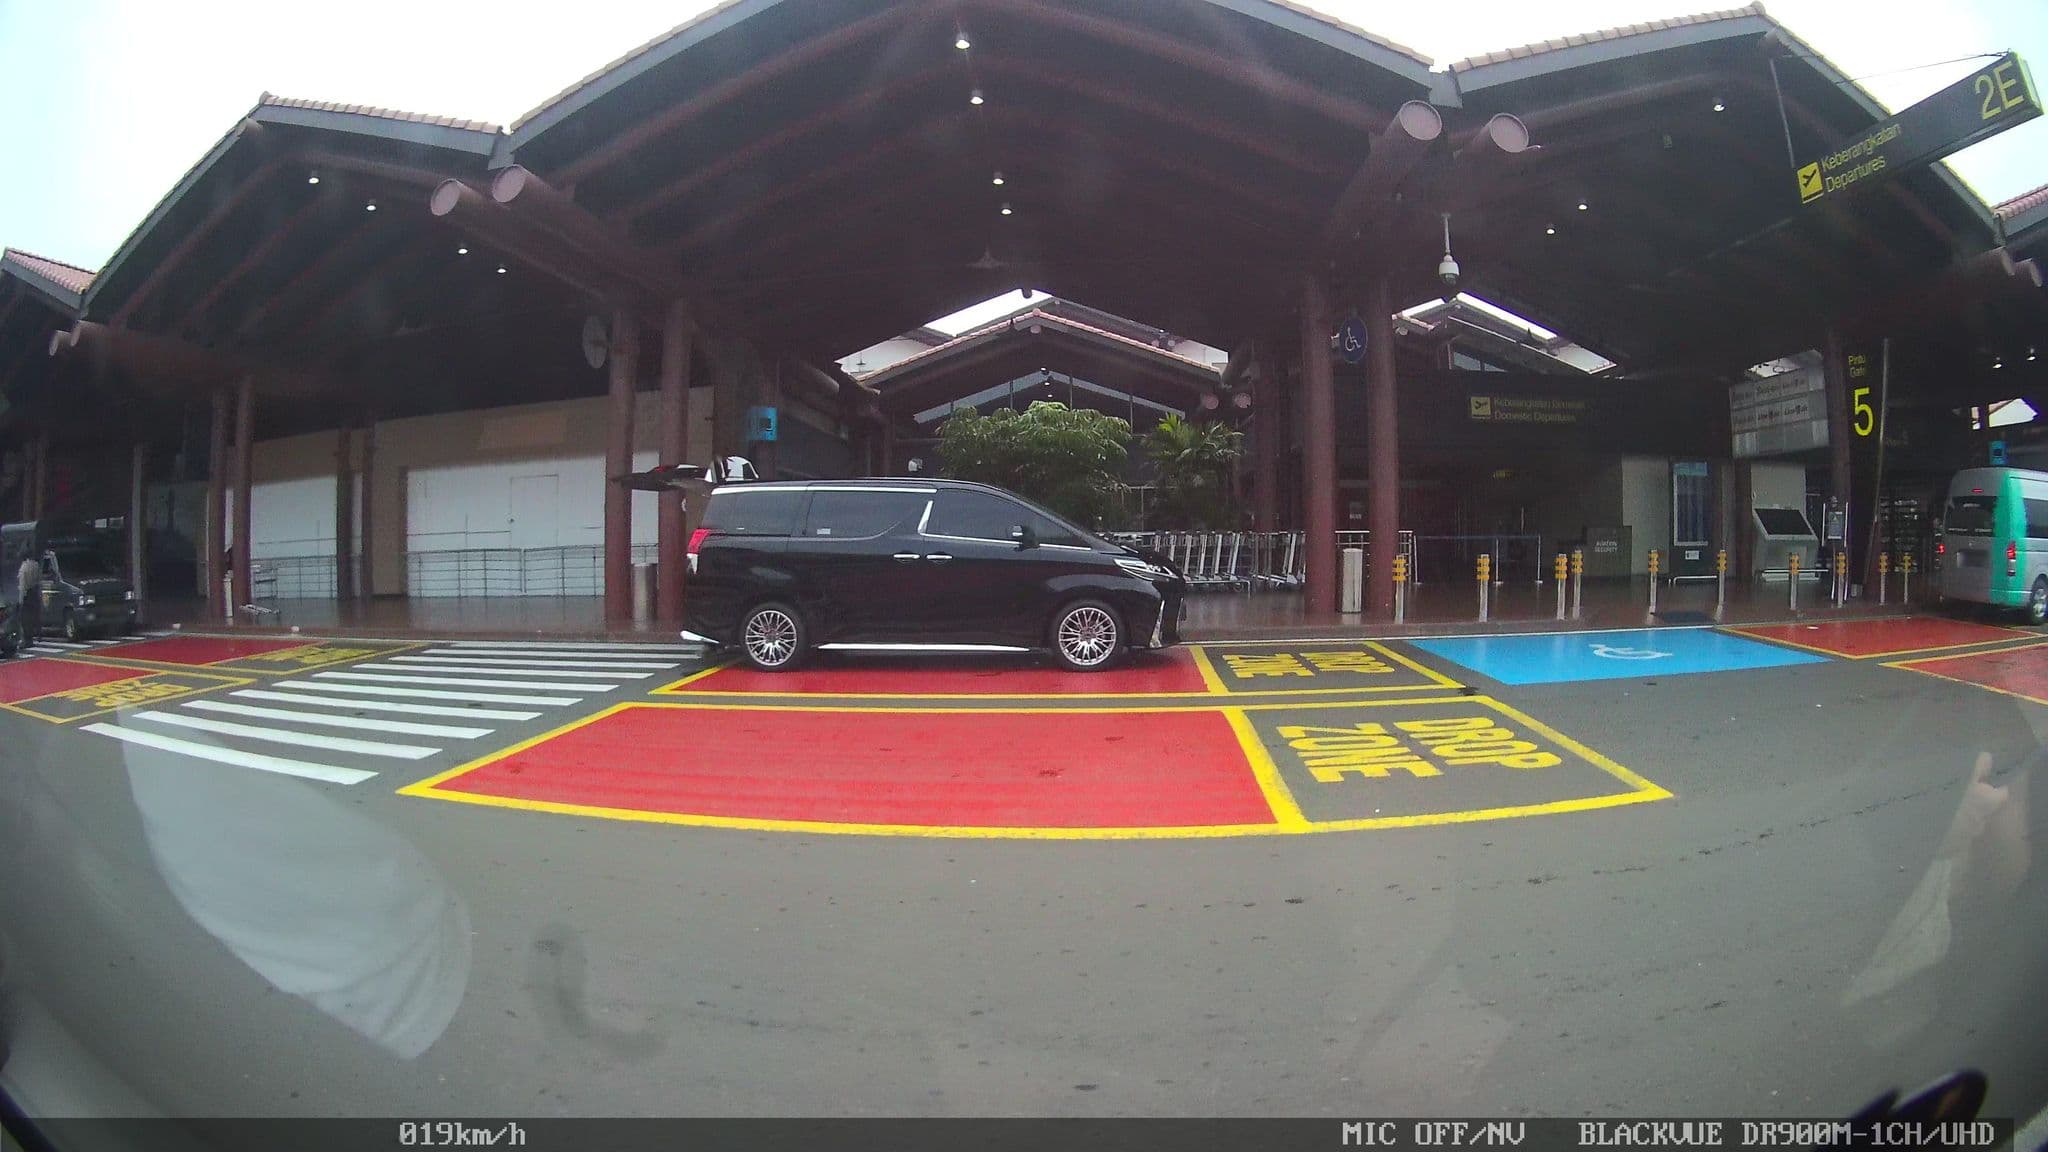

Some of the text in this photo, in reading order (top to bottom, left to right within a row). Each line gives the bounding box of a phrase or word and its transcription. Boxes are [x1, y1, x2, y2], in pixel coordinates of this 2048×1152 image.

[1975, 61, 2025, 119] 2E
[1821, 123, 1902, 171] Keberangkatan
[1825, 154, 1886, 193] Departures
[1853, 386, 1875, 437] 5
[1222, 652, 1316, 678] ZONE
[1299, 650, 1395, 674] DROP
[1276, 723, 1445, 783] ZONE
[1393, 717, 1563, 769] DROP
